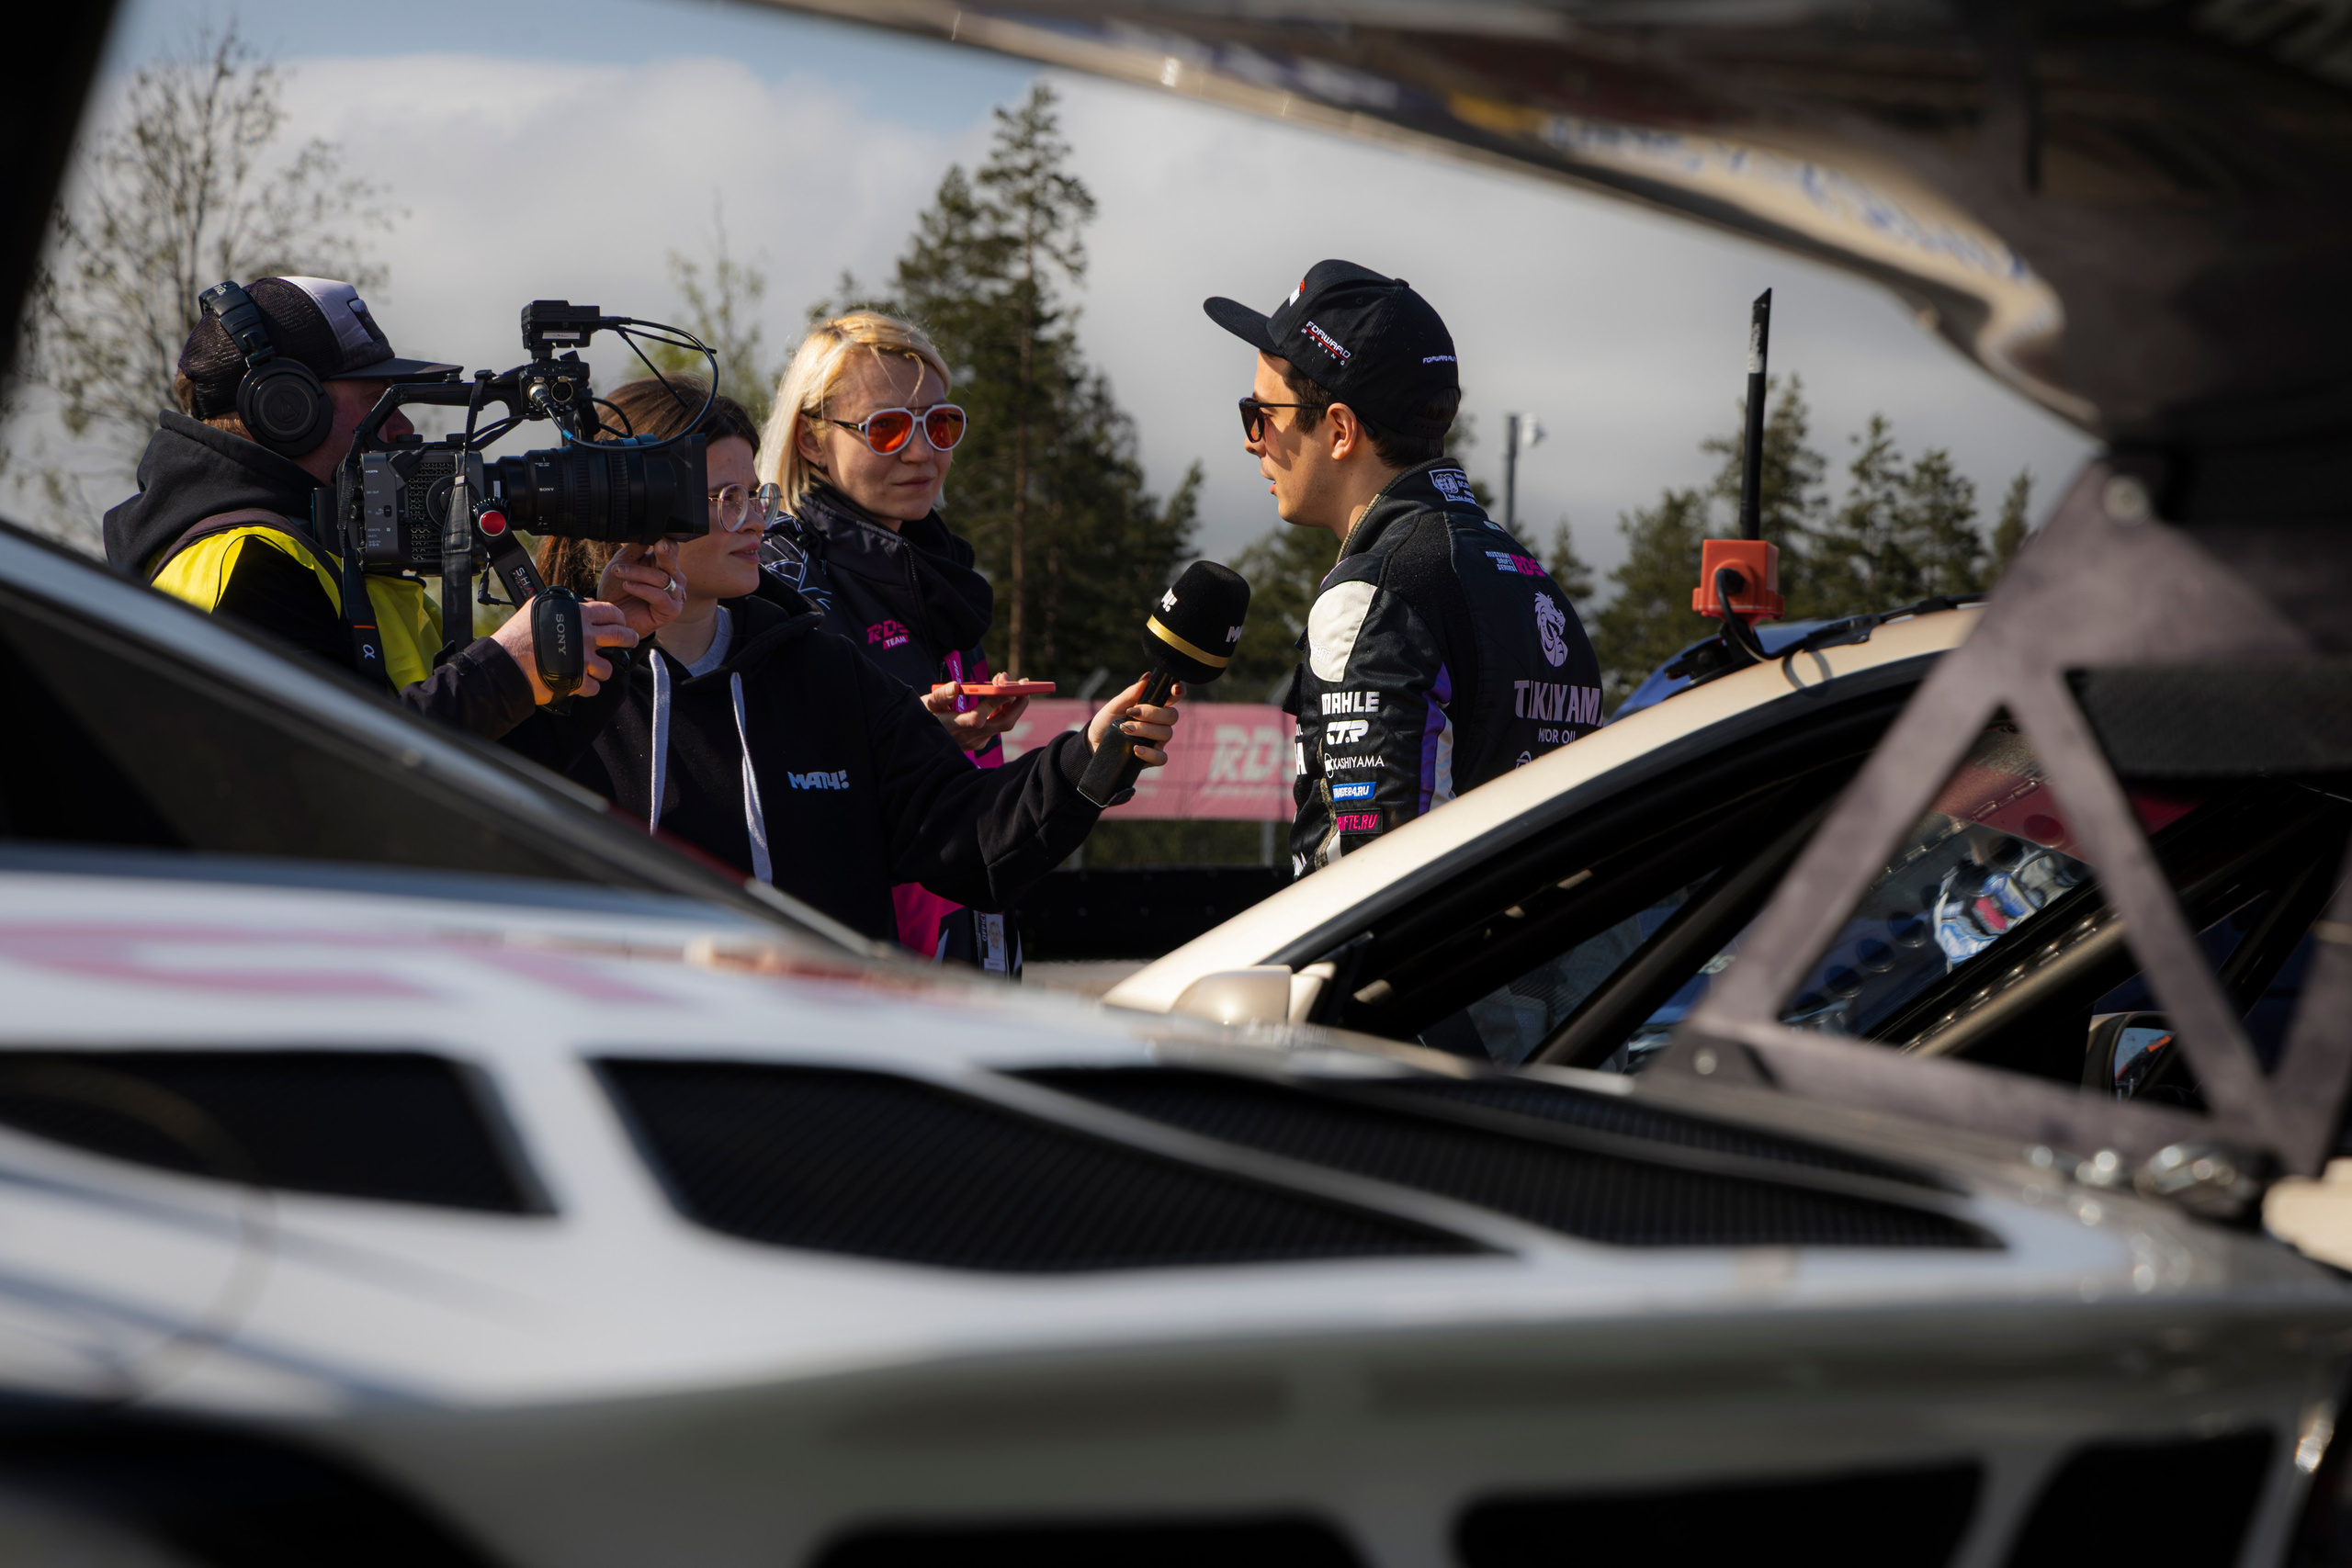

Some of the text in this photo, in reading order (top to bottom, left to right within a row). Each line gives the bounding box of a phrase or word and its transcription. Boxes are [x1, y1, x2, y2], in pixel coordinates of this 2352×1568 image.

[1301, 328, 1345, 366] RACING
[1306, 321, 1351, 358] FORWARD
[1510, 553, 1546, 578] RDS
[556, 614, 567, 656] SONY
[886, 636, 908, 648] TEAM
[1321, 691, 1380, 716] MAHLE
